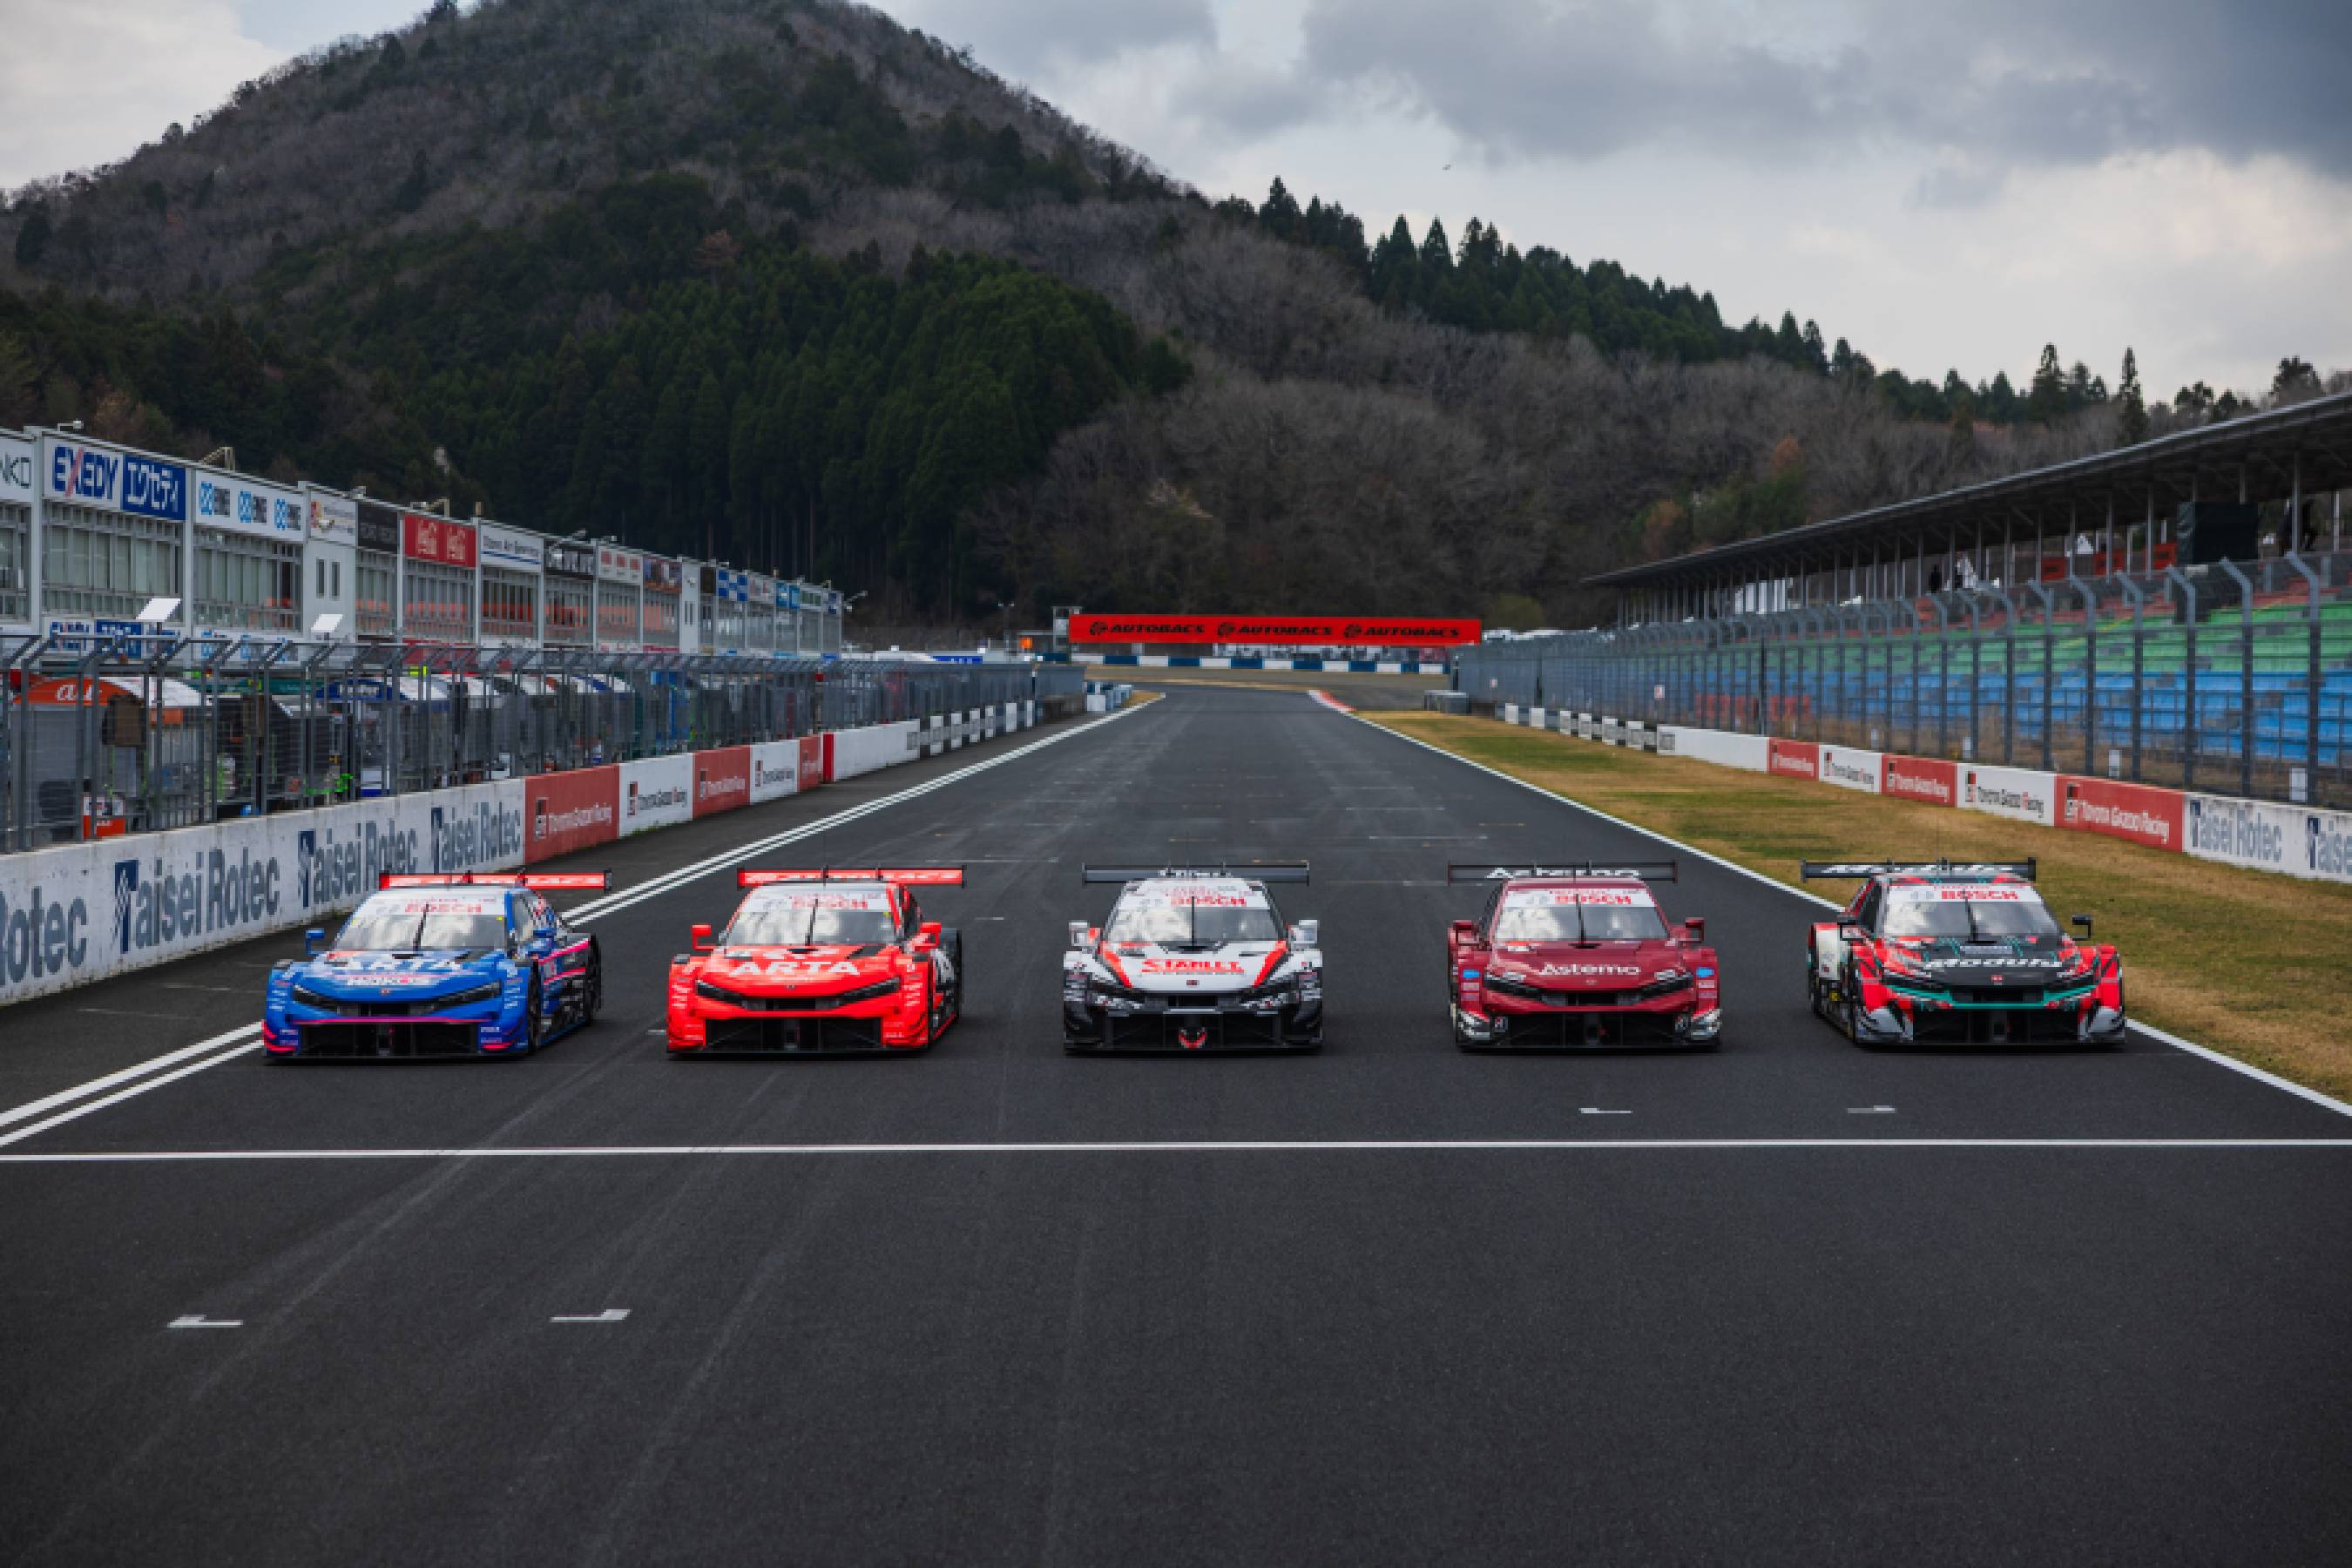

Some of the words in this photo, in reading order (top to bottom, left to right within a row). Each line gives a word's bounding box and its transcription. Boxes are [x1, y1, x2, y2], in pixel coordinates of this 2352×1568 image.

[52, 445, 119, 500] EXEDY
[1111, 623, 1206, 634] AUTOBACS
[1237, 624, 1332, 635] AUTOBACS
[1365, 626, 1460, 638] AUTOBACS
[431, 802, 478, 874] Taisei
[480, 801, 520, 863] Rotec
[2190, 800, 2232, 855] Taisei
[2236, 808, 2281, 863] Rotec
[298, 823, 361, 907] Taisei
[366, 818, 417, 891] Rotec
[114, 850, 204, 955] Taisei
[206, 846, 280, 933] Rotec
[1555, 894, 1632, 905] BOSCH
[1940, 889, 2019, 900] BOSCH
[728, 961, 861, 977] ARTA
[1538, 962, 1641, 977] Astemo
